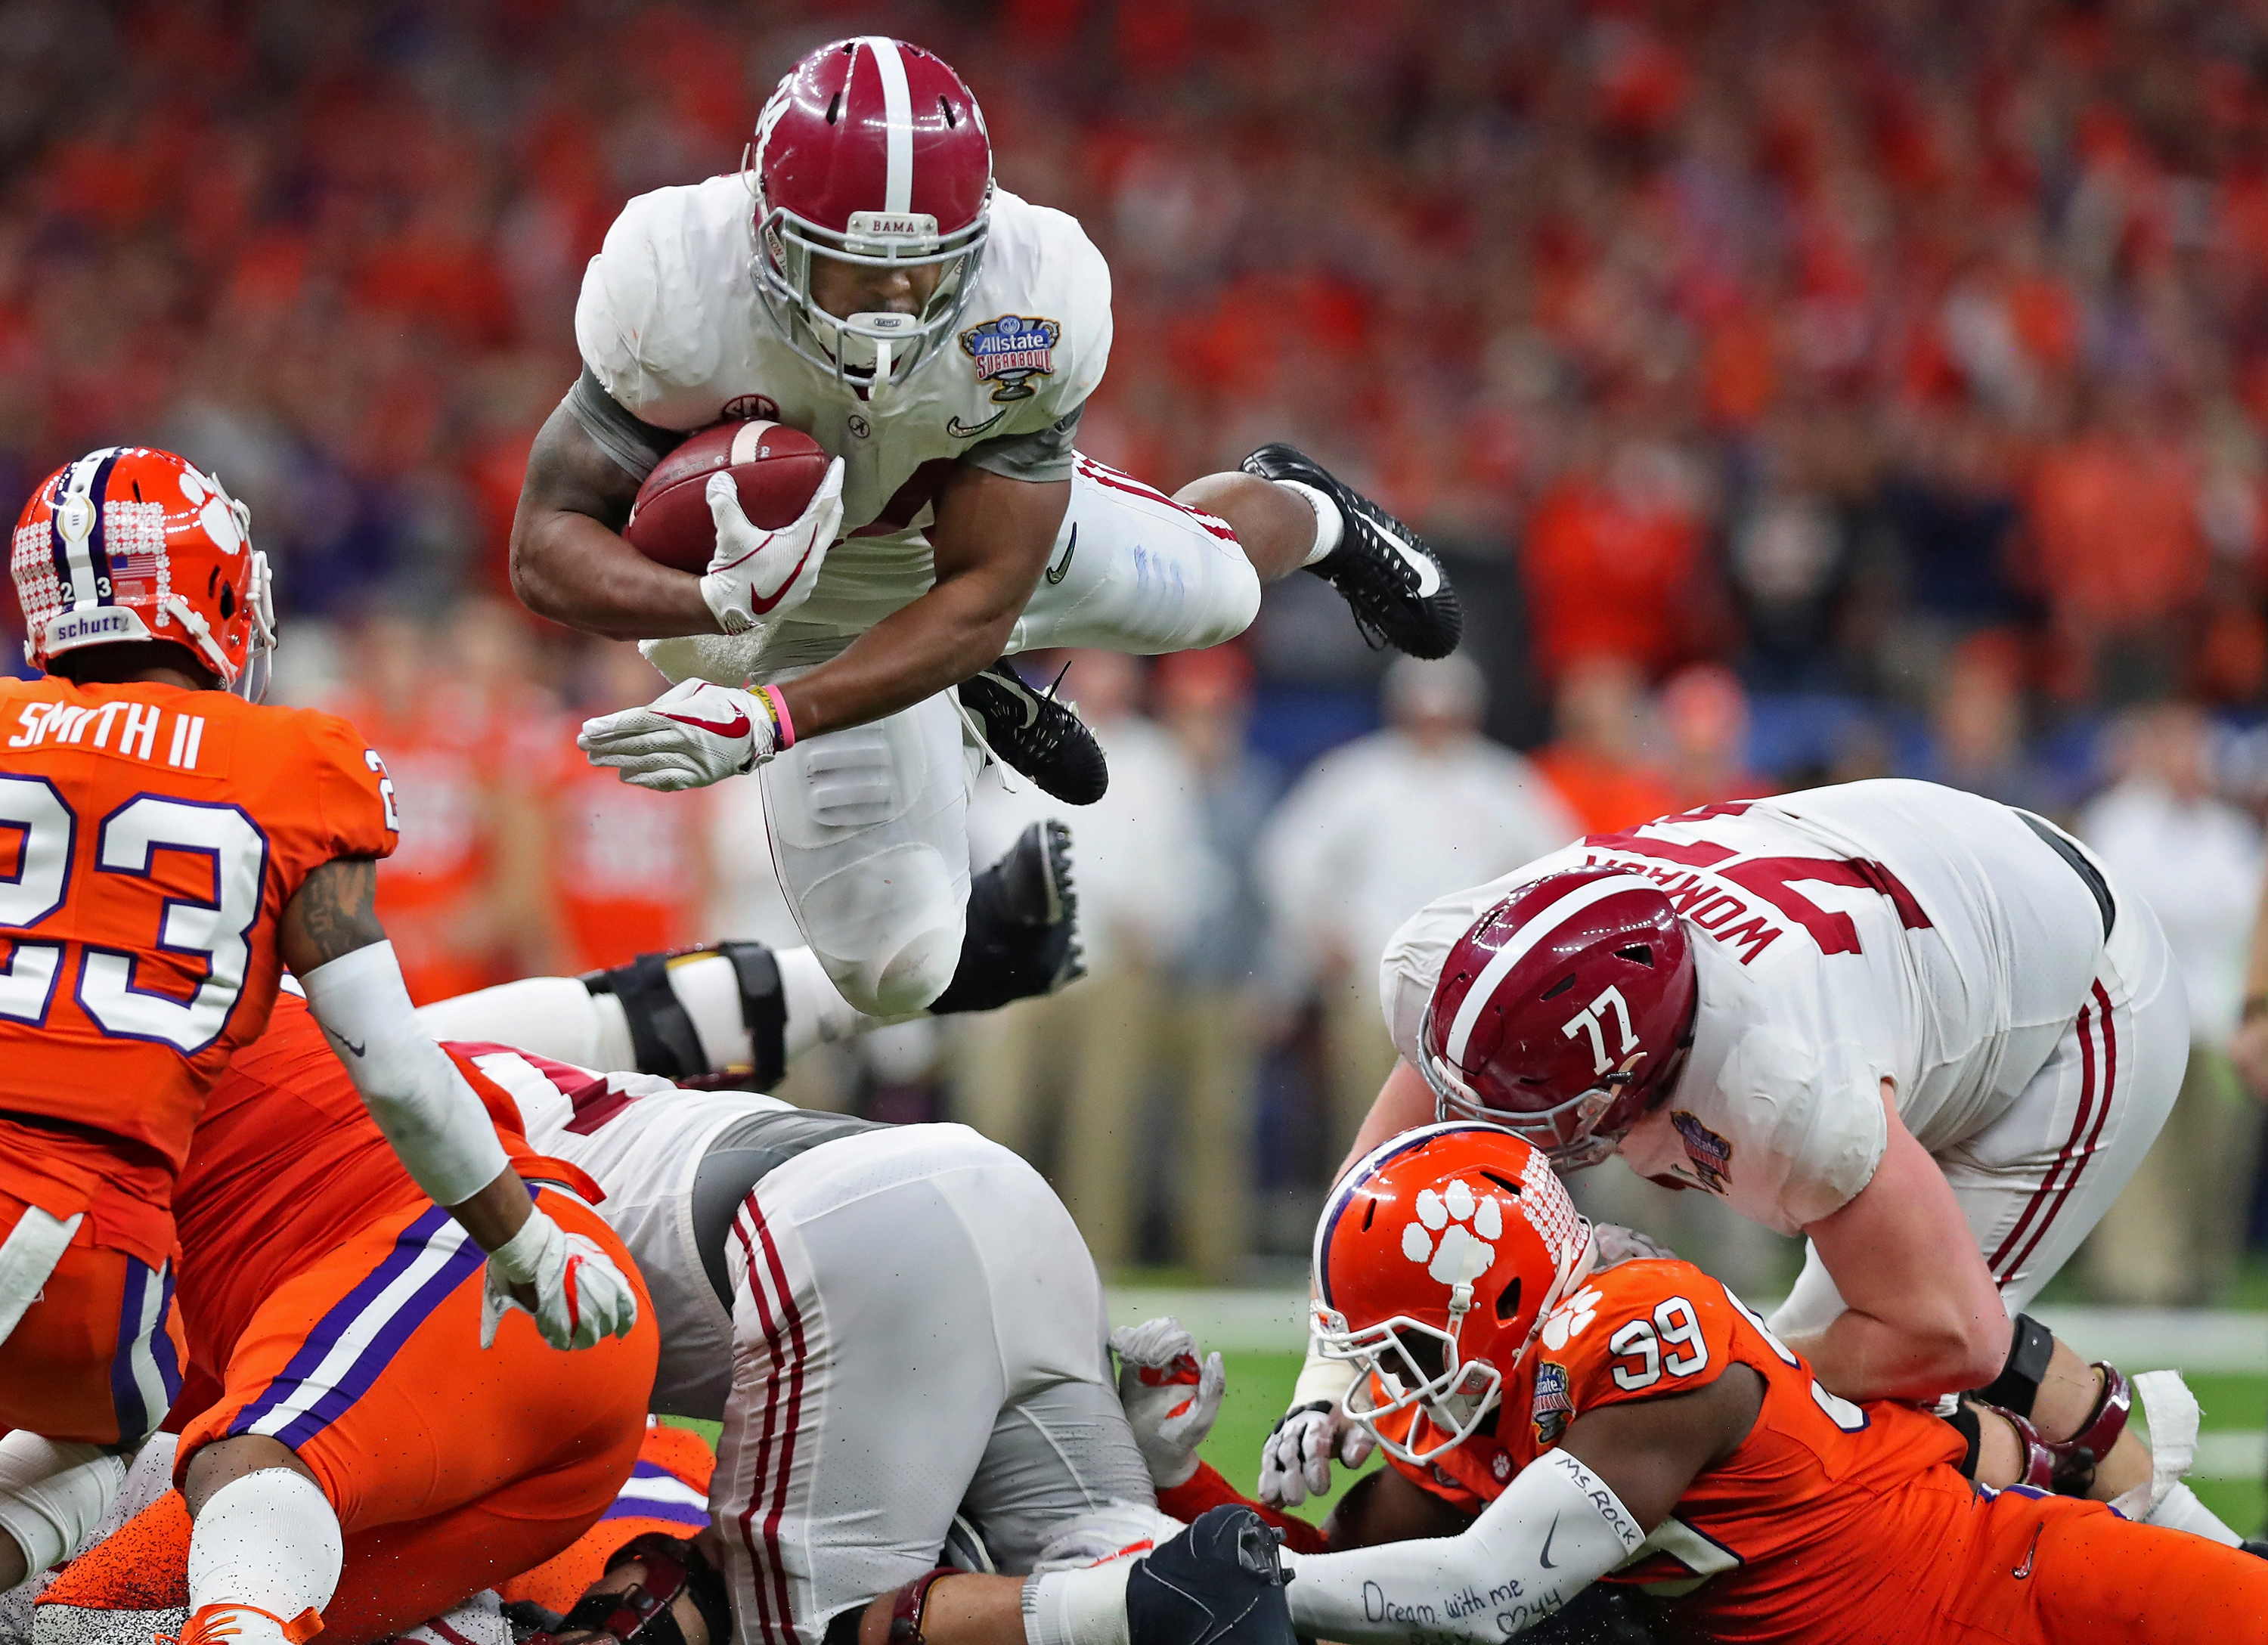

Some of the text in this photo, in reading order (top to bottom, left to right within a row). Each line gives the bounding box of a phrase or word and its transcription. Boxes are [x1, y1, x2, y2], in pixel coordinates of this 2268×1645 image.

[872, 220, 916, 233] BAMA
[978, 333, 1046, 353] Allstate
[58, 616, 120, 640] schutt
[8, 700, 205, 770] SMITH II
[1561, 984, 1641, 1076] 77
[1609, 1294, 1709, 1392] 99
[1588, 1489, 1637, 1546] ROCK
[1363, 1580, 1436, 1624] Dream
[1489, 1578, 1525, 1606] me
[1530, 1588, 1565, 1617] 44
